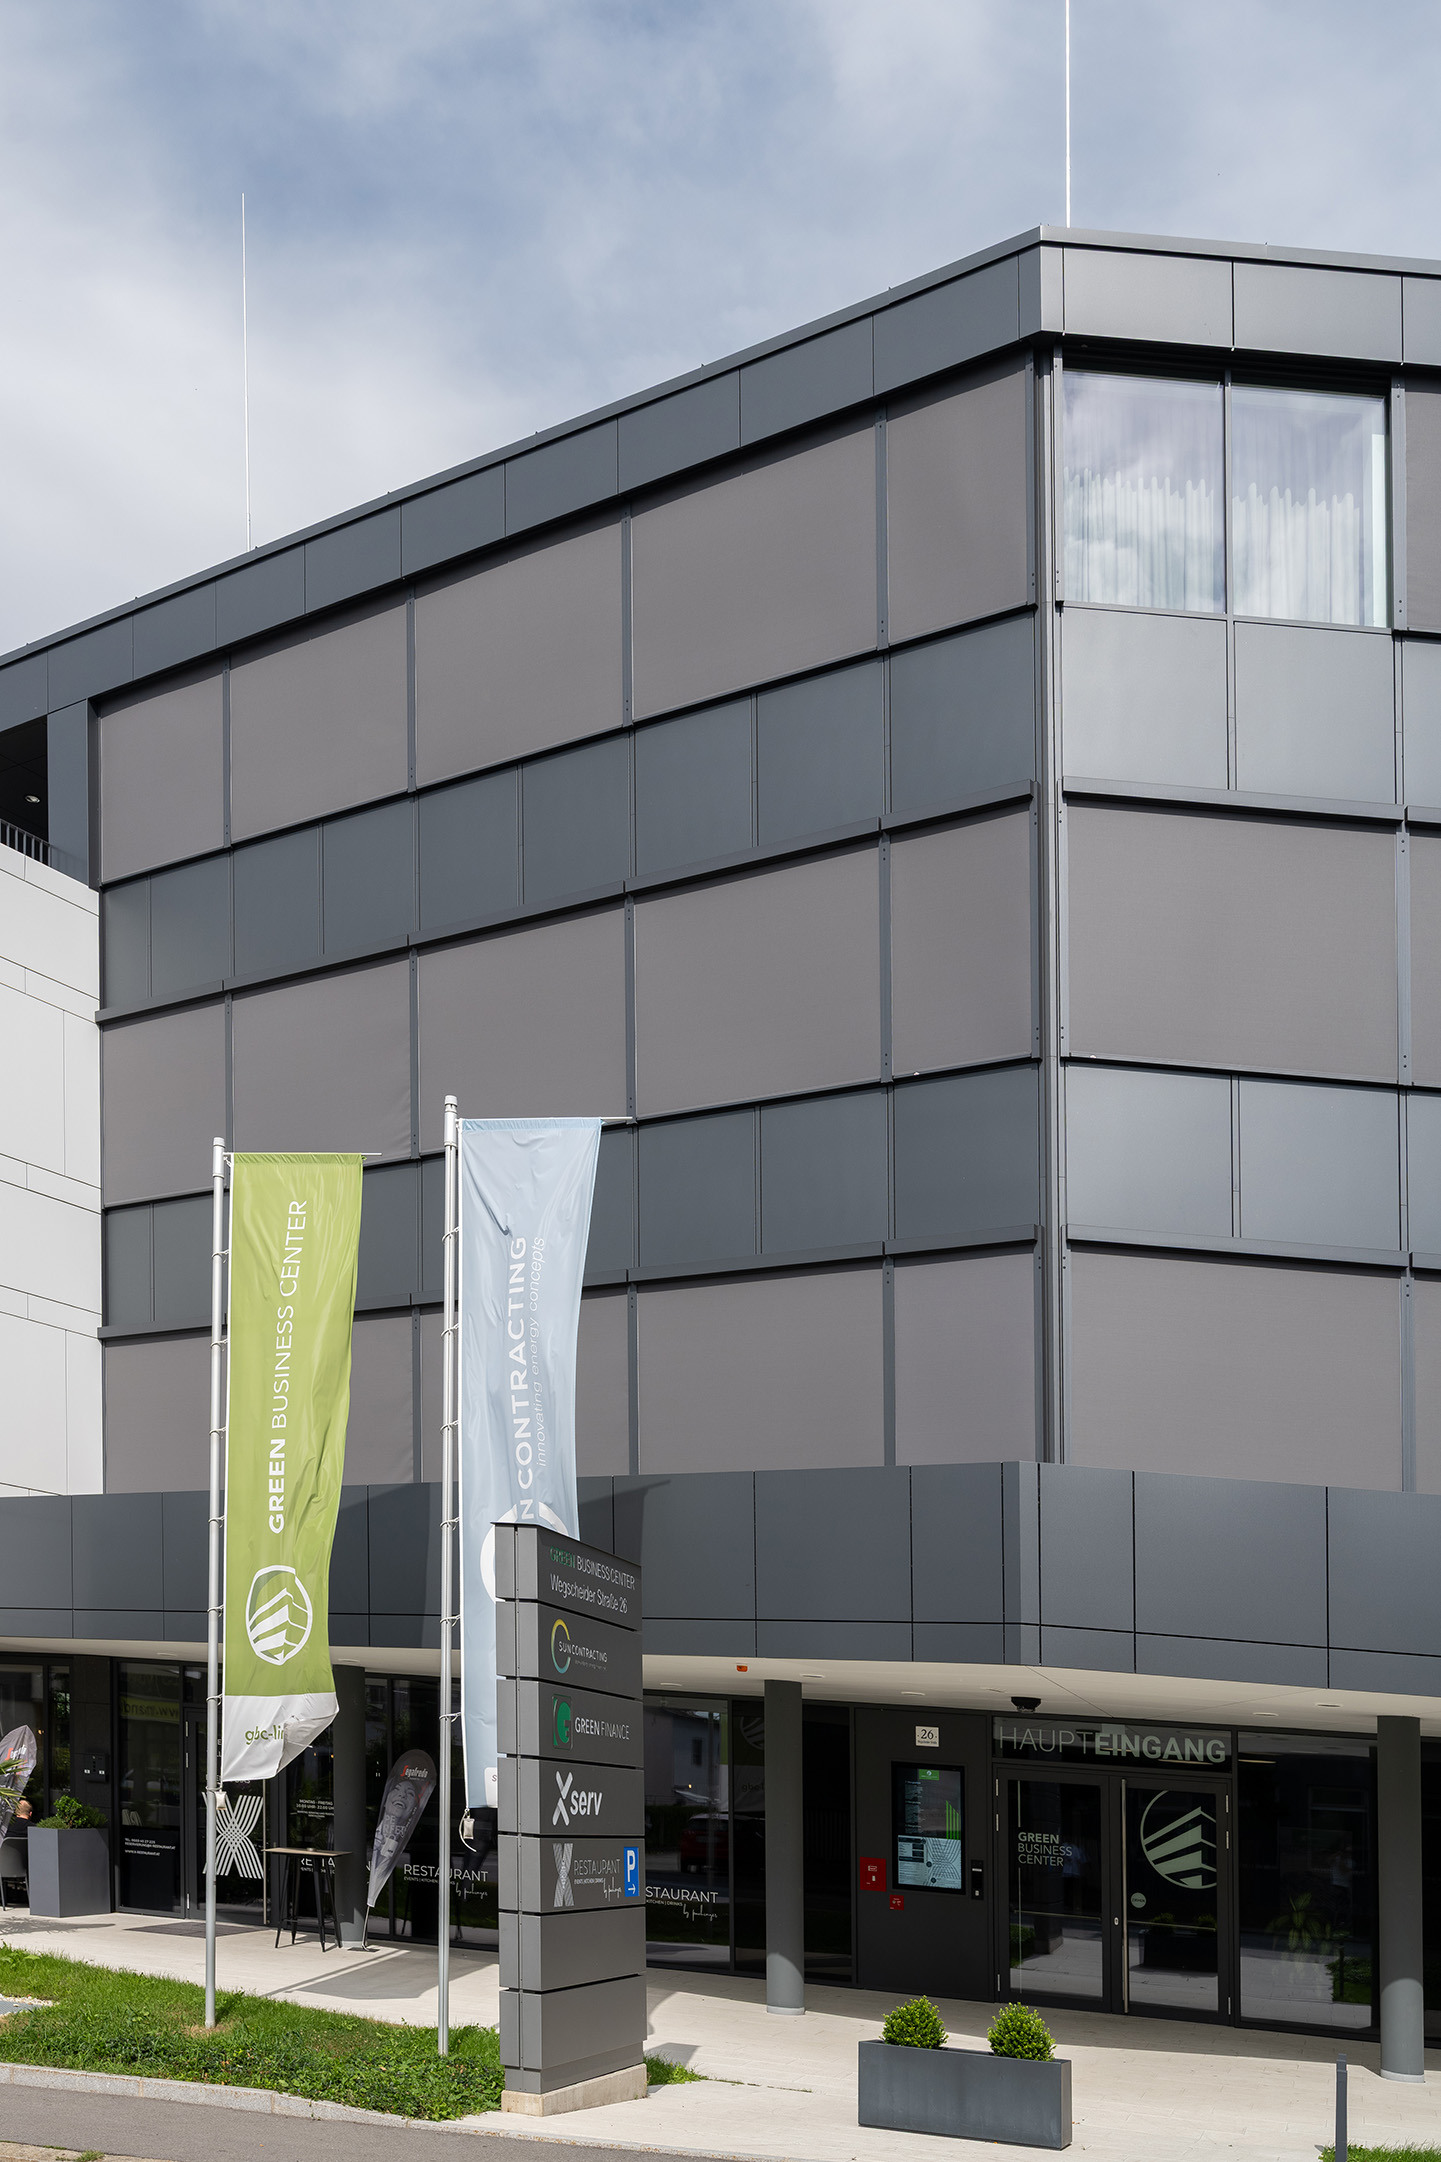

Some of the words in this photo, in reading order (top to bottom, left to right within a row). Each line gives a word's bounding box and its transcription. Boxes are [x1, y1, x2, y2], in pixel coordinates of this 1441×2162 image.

[279, 1200, 307, 1297] CENTER
[529, 1237, 545, 1312] concepts
[507, 1237, 534, 1489] CONTRACTING
[530, 1317, 540, 1375] energy
[271, 1304, 295, 1429] BUSINESS
[533, 1382, 546, 1467] innovating
[269, 1439, 286, 1534] GREEN
[550, 1546, 575, 1569] GREEN
[577, 1555, 611, 1582] BUSINESS
[610, 1568, 635, 1590] CENTER
[550, 1573, 596, 1604] Wegscheider
[597, 1588, 619, 1611] Straße
[619, 1597, 628, 1614] 26
[245, 1724, 284, 1745] gbc-li
[574, 1716, 600, 1736] GREEN
[600, 1721, 630, 1740] FINANCE
[921, 1729, 934, 1740] 26
[1000, 1726, 1226, 1763] HAUPTEINGANG
[1018, 1832, 1059, 1844] GREEN
[1018, 1843, 1072, 1856] BUSINESS
[574, 1859, 620, 1876] RESTAURANT
[627, 1850, 636, 1882] P
[1018, 1854, 1064, 1867] CENTER
[645, 1886, 719, 1903] STAURANT
